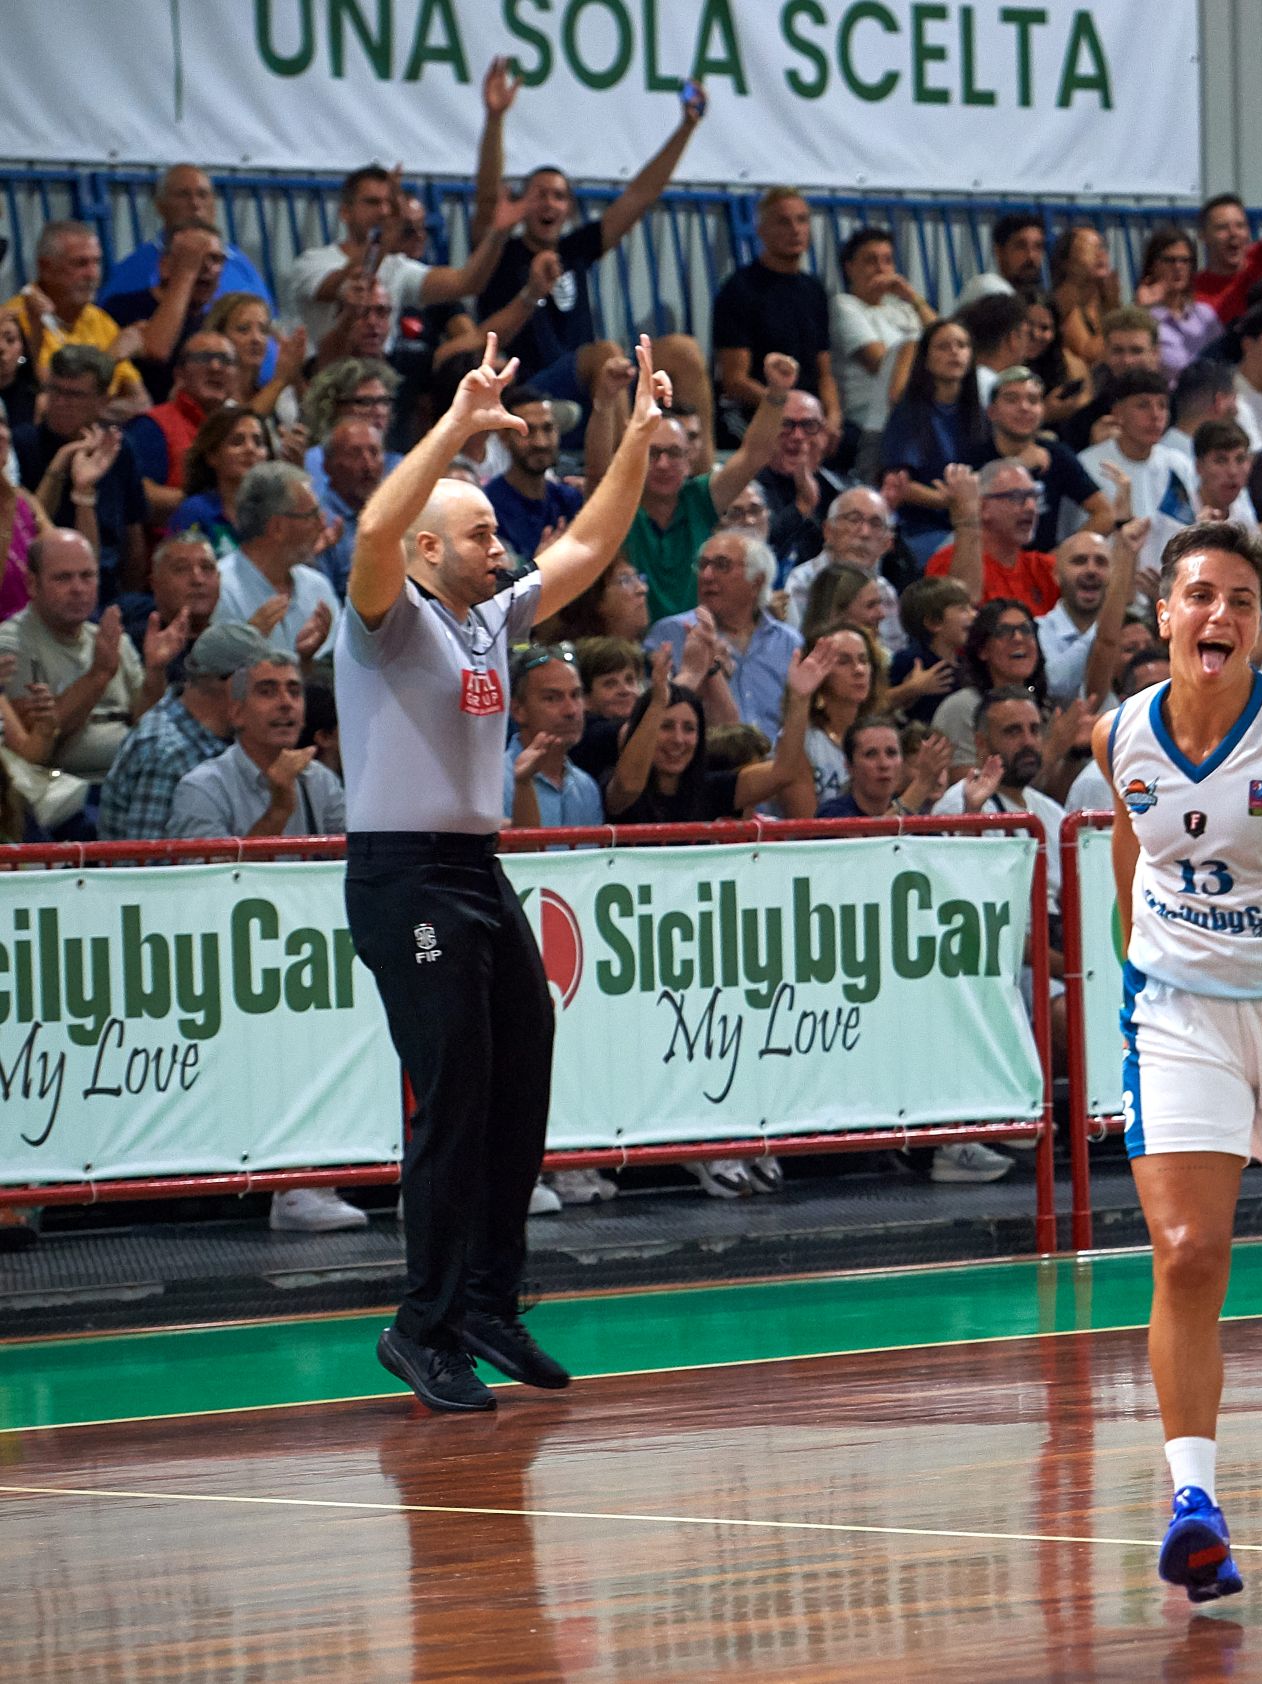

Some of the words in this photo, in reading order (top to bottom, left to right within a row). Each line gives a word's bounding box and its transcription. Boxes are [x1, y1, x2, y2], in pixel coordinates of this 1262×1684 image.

[256, 0, 471, 83] UNA
[503, 0, 749, 95] SOLA
[780, 0, 1114, 110] SCELTA
[1174, 858, 1235, 896] 13
[121, 904, 222, 1040] by
[415, 949, 442, 964] FIP
[594, 880, 785, 1010] Sicily
[793, 876, 882, 1004] by
[890, 870, 1011, 980] Car
[83, 1017, 200, 1100] Love
[656, 986, 744, 1104] My
[758, 982, 862, 1061] Love
